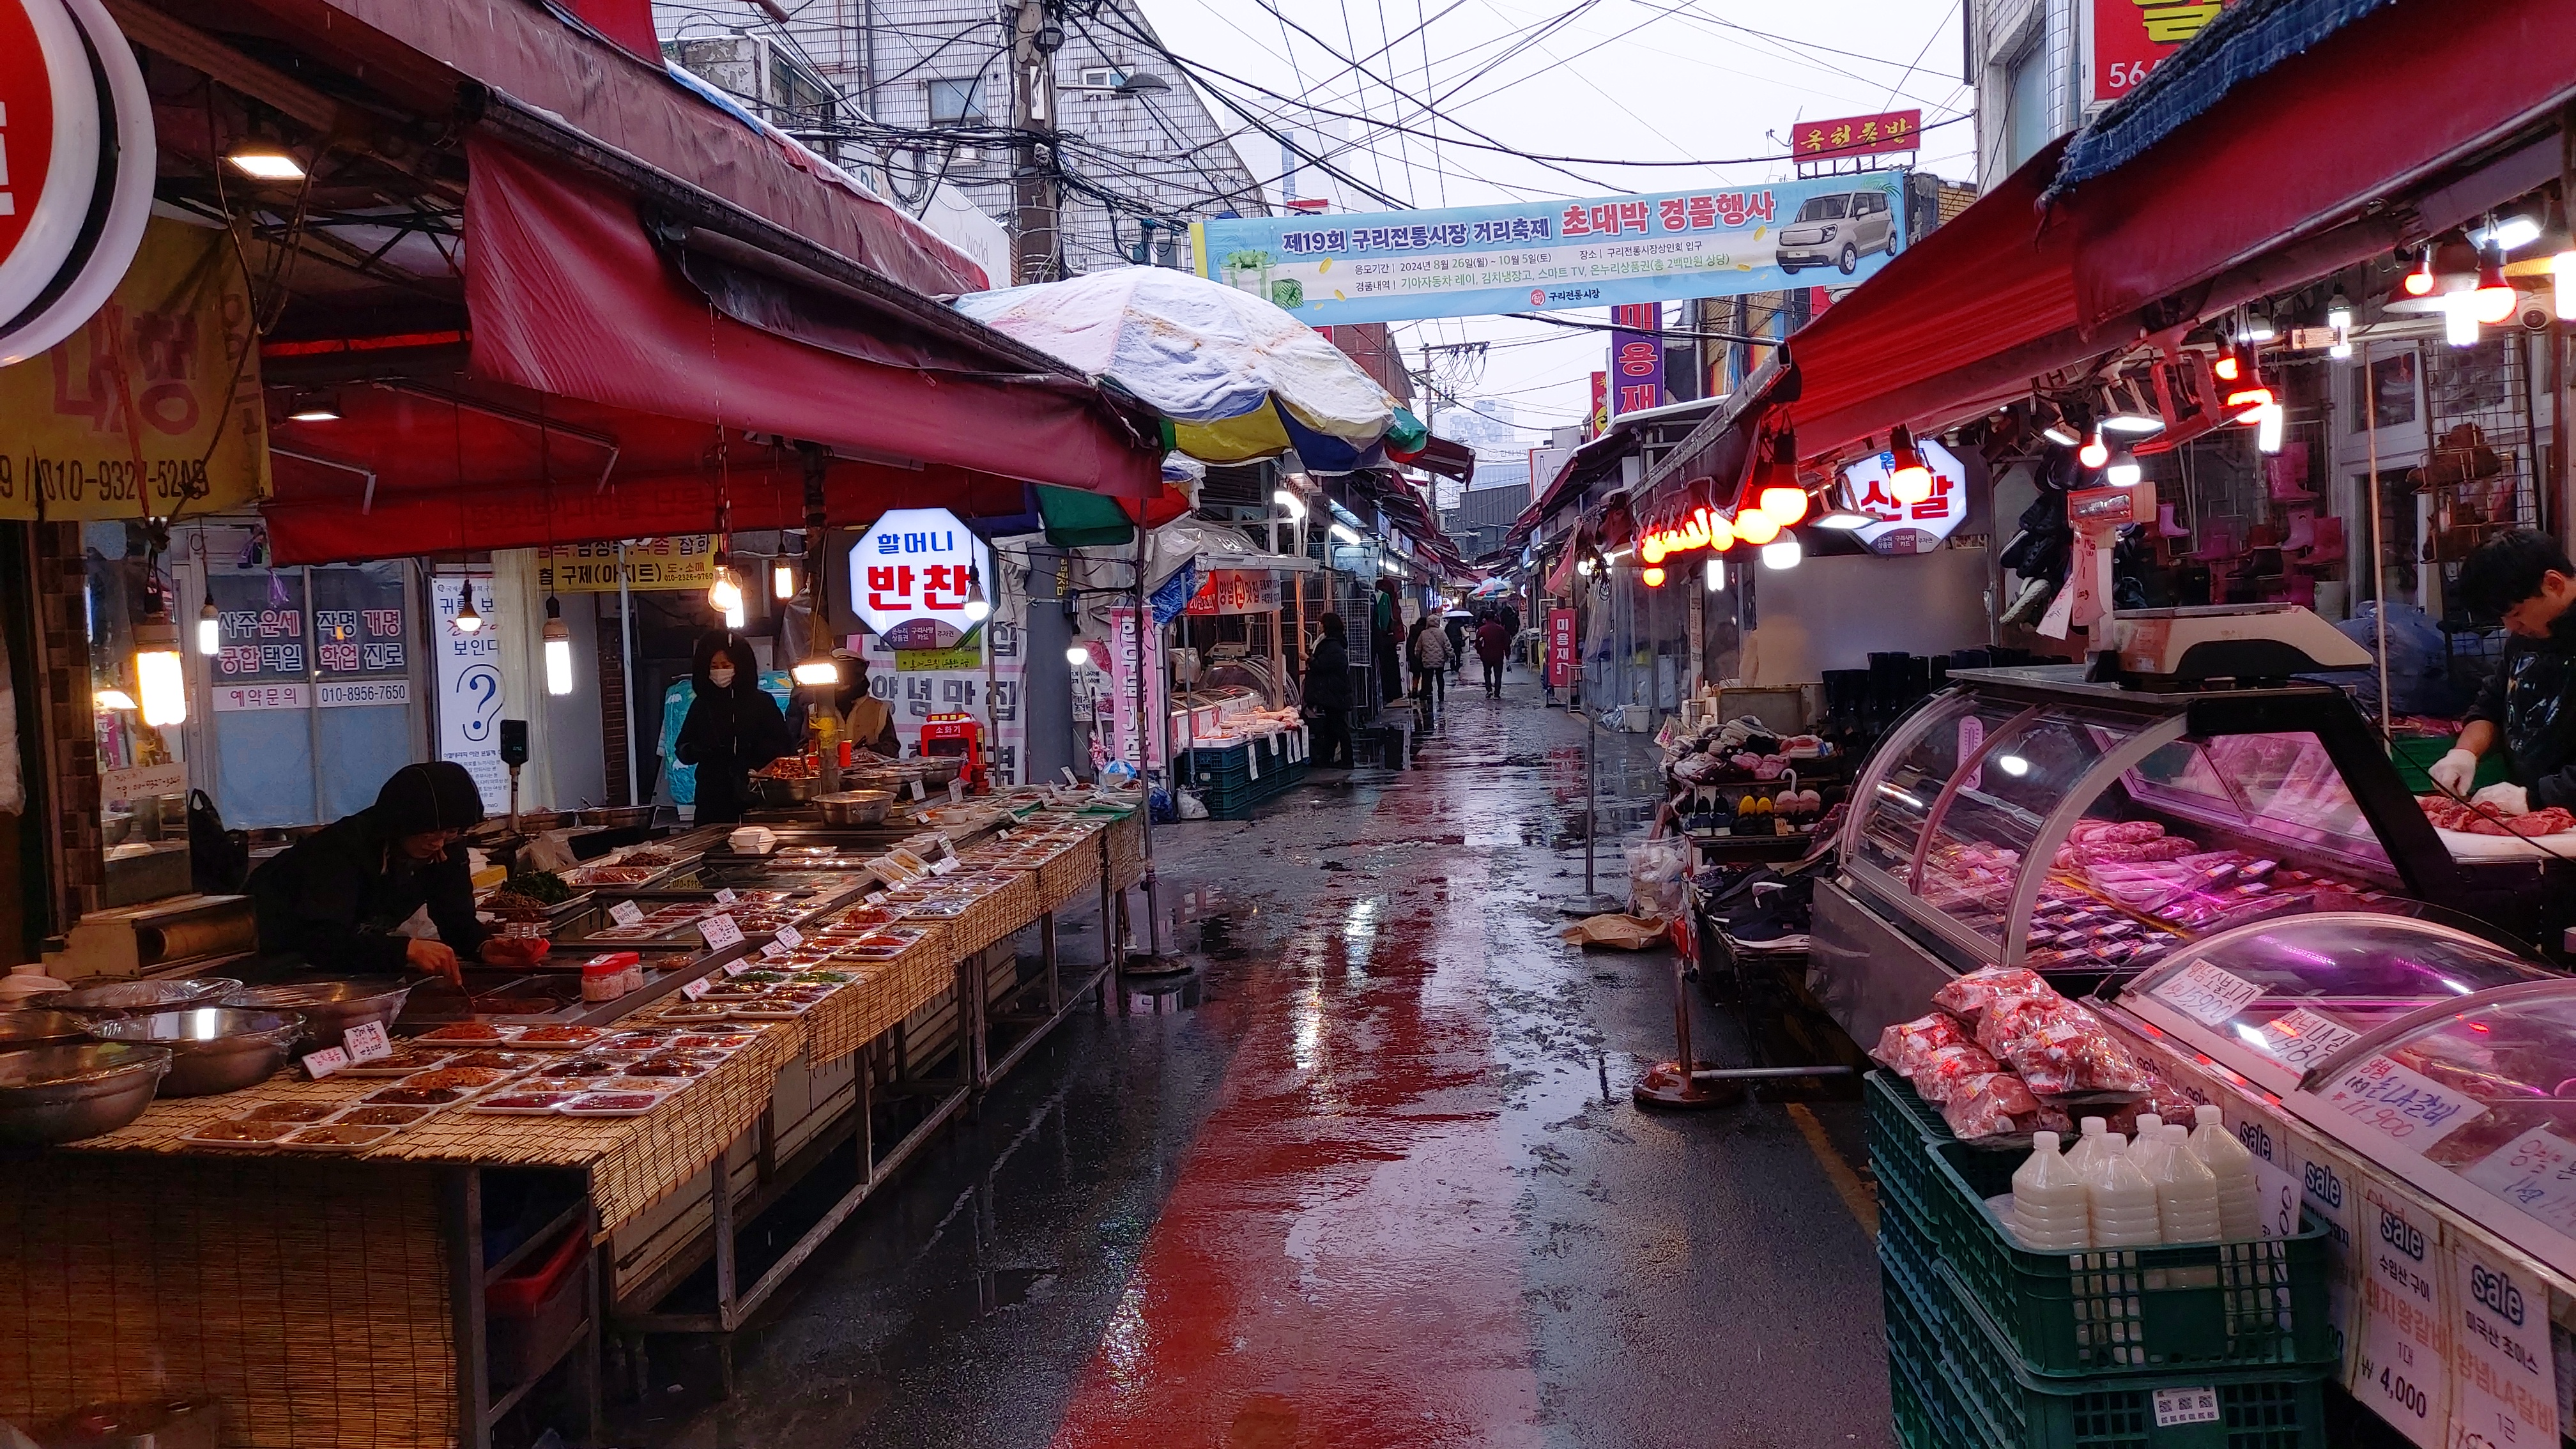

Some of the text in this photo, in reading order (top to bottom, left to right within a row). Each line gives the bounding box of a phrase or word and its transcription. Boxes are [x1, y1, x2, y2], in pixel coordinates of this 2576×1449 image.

[2108, 59, 2161, 88] 56
[1283, 190, 1775, 253] 제19회 구리전통시장 거리축제 초대박 경품행사
[965, 233, 988, 266] world
[1354, 263, 1390, 275] 응모기간
[1400, 260, 1431, 272] 2024년
[1434, 257, 1448, 269] 8월
[1452, 256, 1489, 268] 26일(월)
[1499, 254, 1519, 266] 10월
[1522, 252, 1552, 264] 5일(토)
[1579, 240, 1703, 260] 장소 구리전통시장상인회 입구
[1355, 279, 1390, 292] 경품내역
[1401, 275, 1452, 290] 기아자동차
[1455, 274, 1480, 288] 레이,
[1482, 270, 1535, 286] 김치냉장고,
[1538, 266, 1568, 280] 스마트
[1572, 266, 1588, 278] TV,
[1666, 255, 1703, 269] 2백만원
[1706, 253, 1730, 267] 상당)
[1549, 287, 1601, 302] 구리전통시장
[877, 531, 953, 555] 할머니
[868, 565, 970, 611] 반찬
[218, 610, 402, 638] 사주 운세 작명 개명
[219, 643, 404, 674] 궁합 택일 학업 진로
[231, 687, 298, 707] 예약문의
[321, 684, 406, 702] 010-8956-7650
[935, 725, 962, 734] 소화기
[2240, 1120, 2272, 1162] sale
[2304, 1160, 2342, 1209] sale
[2380, 1209, 2425, 1262] sale
[2379, 1254, 2430, 1303] 수입산 구이
[2471, 1264, 2524, 1326] sale
[2380, 1366, 2427, 1419] 4,000
